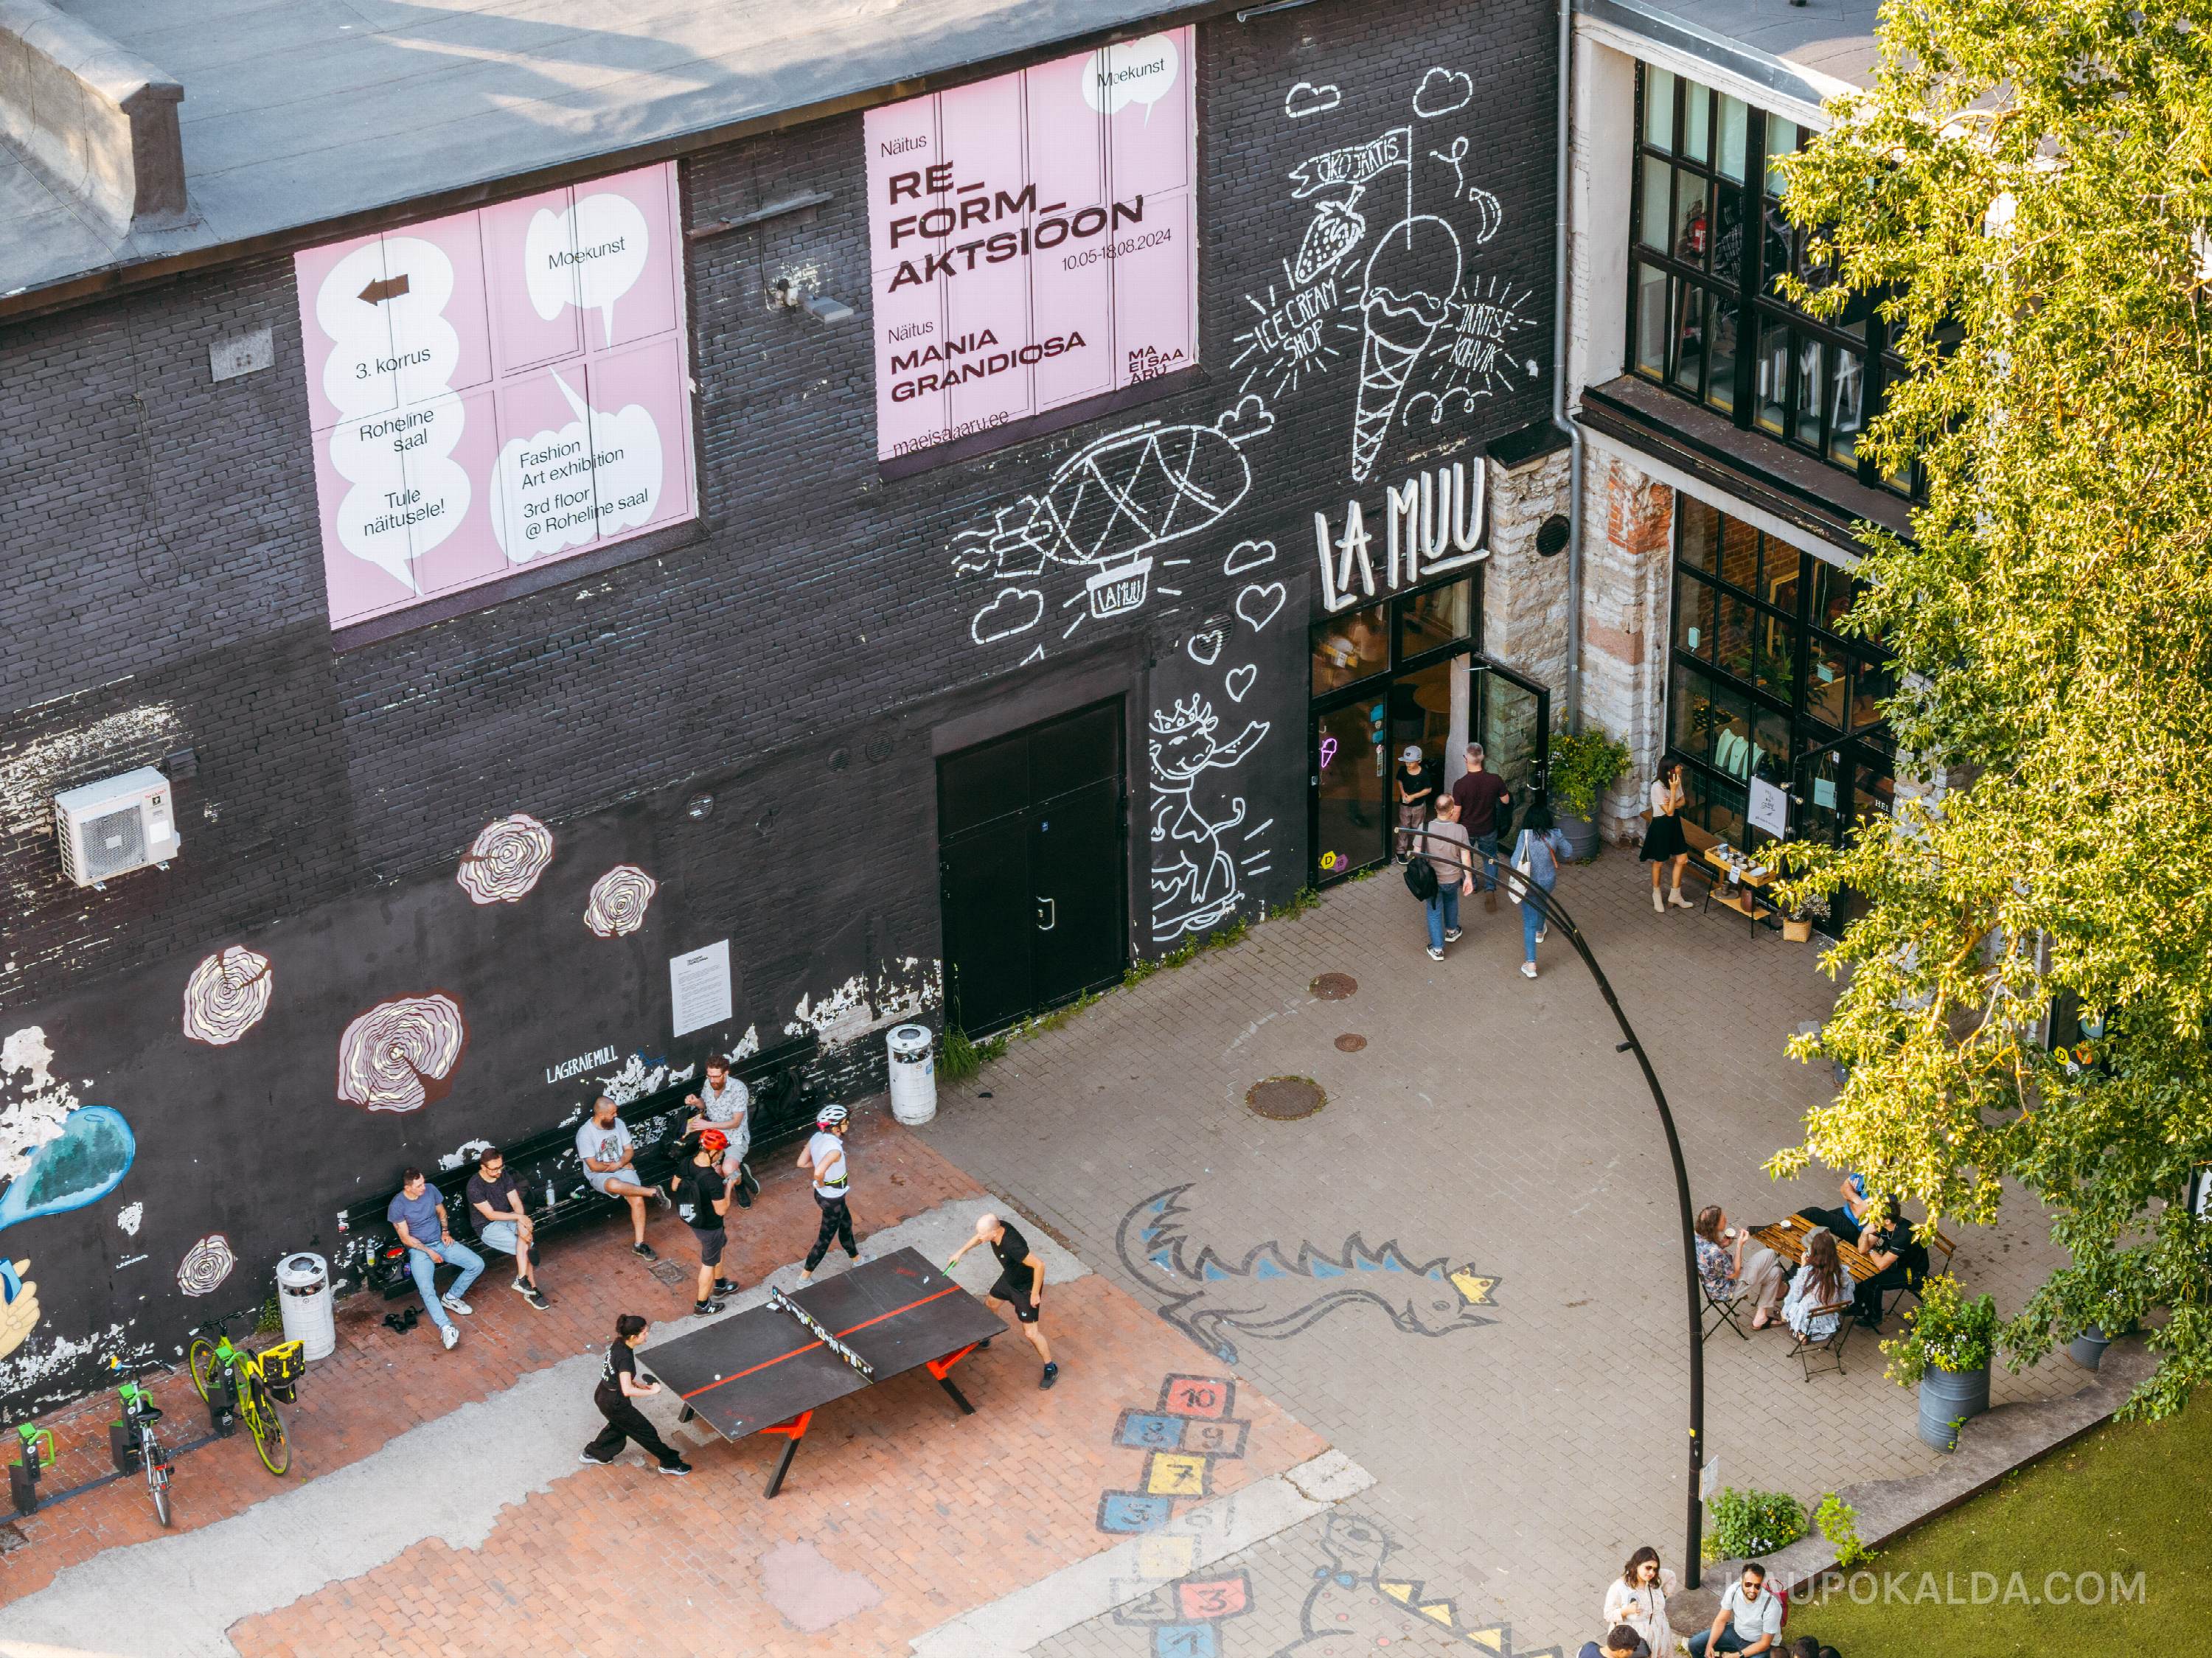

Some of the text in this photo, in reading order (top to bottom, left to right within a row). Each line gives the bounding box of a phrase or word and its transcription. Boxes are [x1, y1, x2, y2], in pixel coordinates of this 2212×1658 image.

[1097, 58, 1166, 87] Moekunst
[881, 135, 927, 157] Näitus
[548, 236, 626, 270] Moekunst
[888, 194, 1144, 293] AKTSIOON
[1062, 228, 1172, 271] 10.05-18.08.2024
[1254, 278, 1338, 354] ICE CREAM
[888, 320, 933, 344] Näitus
[1283, 319, 1323, 367] SHOP
[355, 347, 431, 380] 3. korrus
[891, 328, 998, 375] MANIA
[1128, 345, 1157, 362] MA
[1129, 349, 1184, 373] EI SAA
[1448, 334, 1503, 373] KOHVIK
[891, 331, 1086, 403] GRANDIOSA
[1130, 363, 1167, 386] ARU
[360, 409, 434, 442] Roheline
[393, 431, 428, 453] saal
[519, 441, 581, 468] Fashion
[521, 447, 625, 490] Art exhibition
[385, 488, 421, 509] Tule
[524, 487, 591, 518] 3rd floor
[364, 499, 445, 536] näitusele!
[525, 489, 649, 540] @ Roheline saal
[1315, 456, 1486, 612] LA MUU
[1097, 580, 1141, 612] LA MUU
[1325, 856, 1332, 865] D
[2059, 1051, 2066, 1061] D
[1180, 1388, 1216, 1407] 10
[1141, 1422, 1164, 1443] 8
[1202, 1427, 1224, 1449] 9
[1166, 1464, 1194, 1487] 7
[1198, 1589, 1227, 1612] 3
[1172, 1630, 1198, 1656] 1
